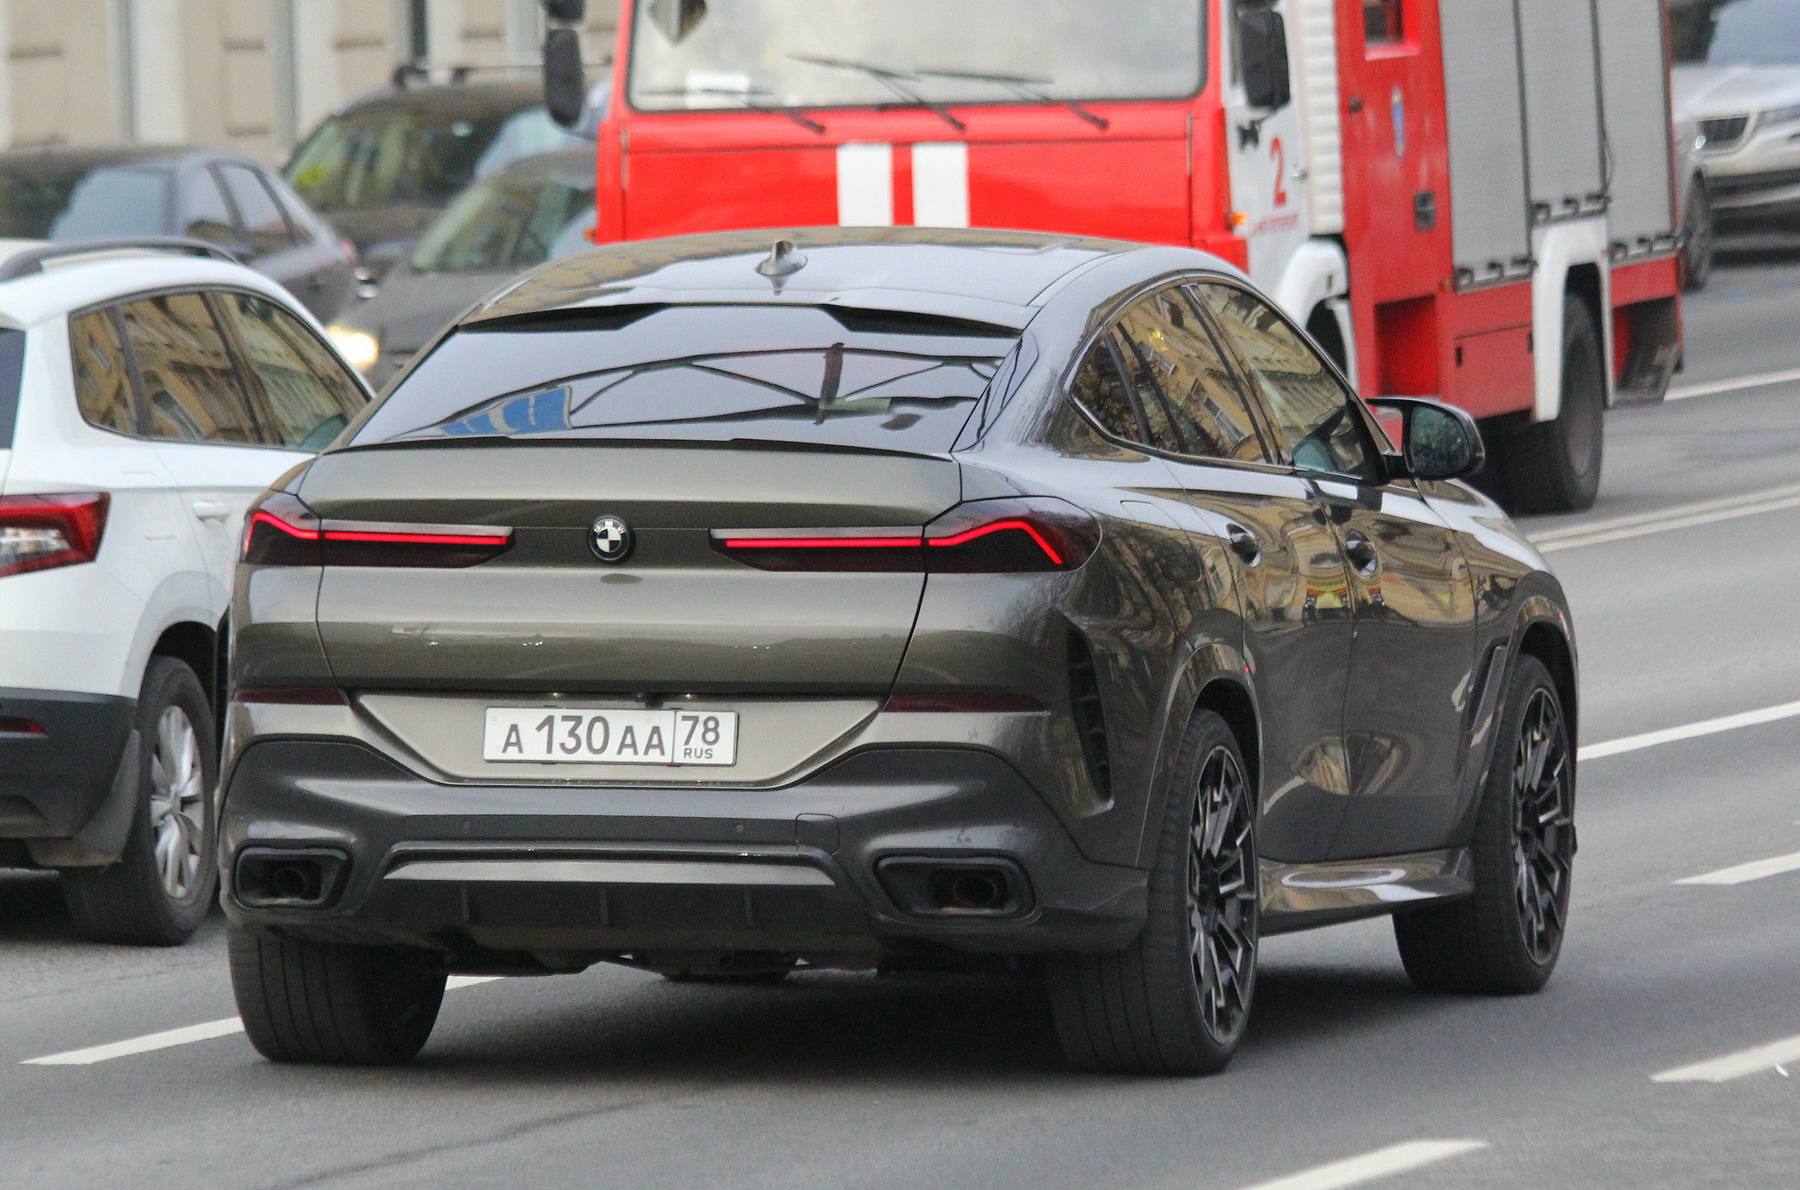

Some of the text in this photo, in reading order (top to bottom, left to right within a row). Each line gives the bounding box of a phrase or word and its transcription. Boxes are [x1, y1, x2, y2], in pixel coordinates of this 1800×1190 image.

[1270, 137, 1288, 208] 2
[681, 715, 721, 747] 78
[683, 747, 714, 760] RUS
